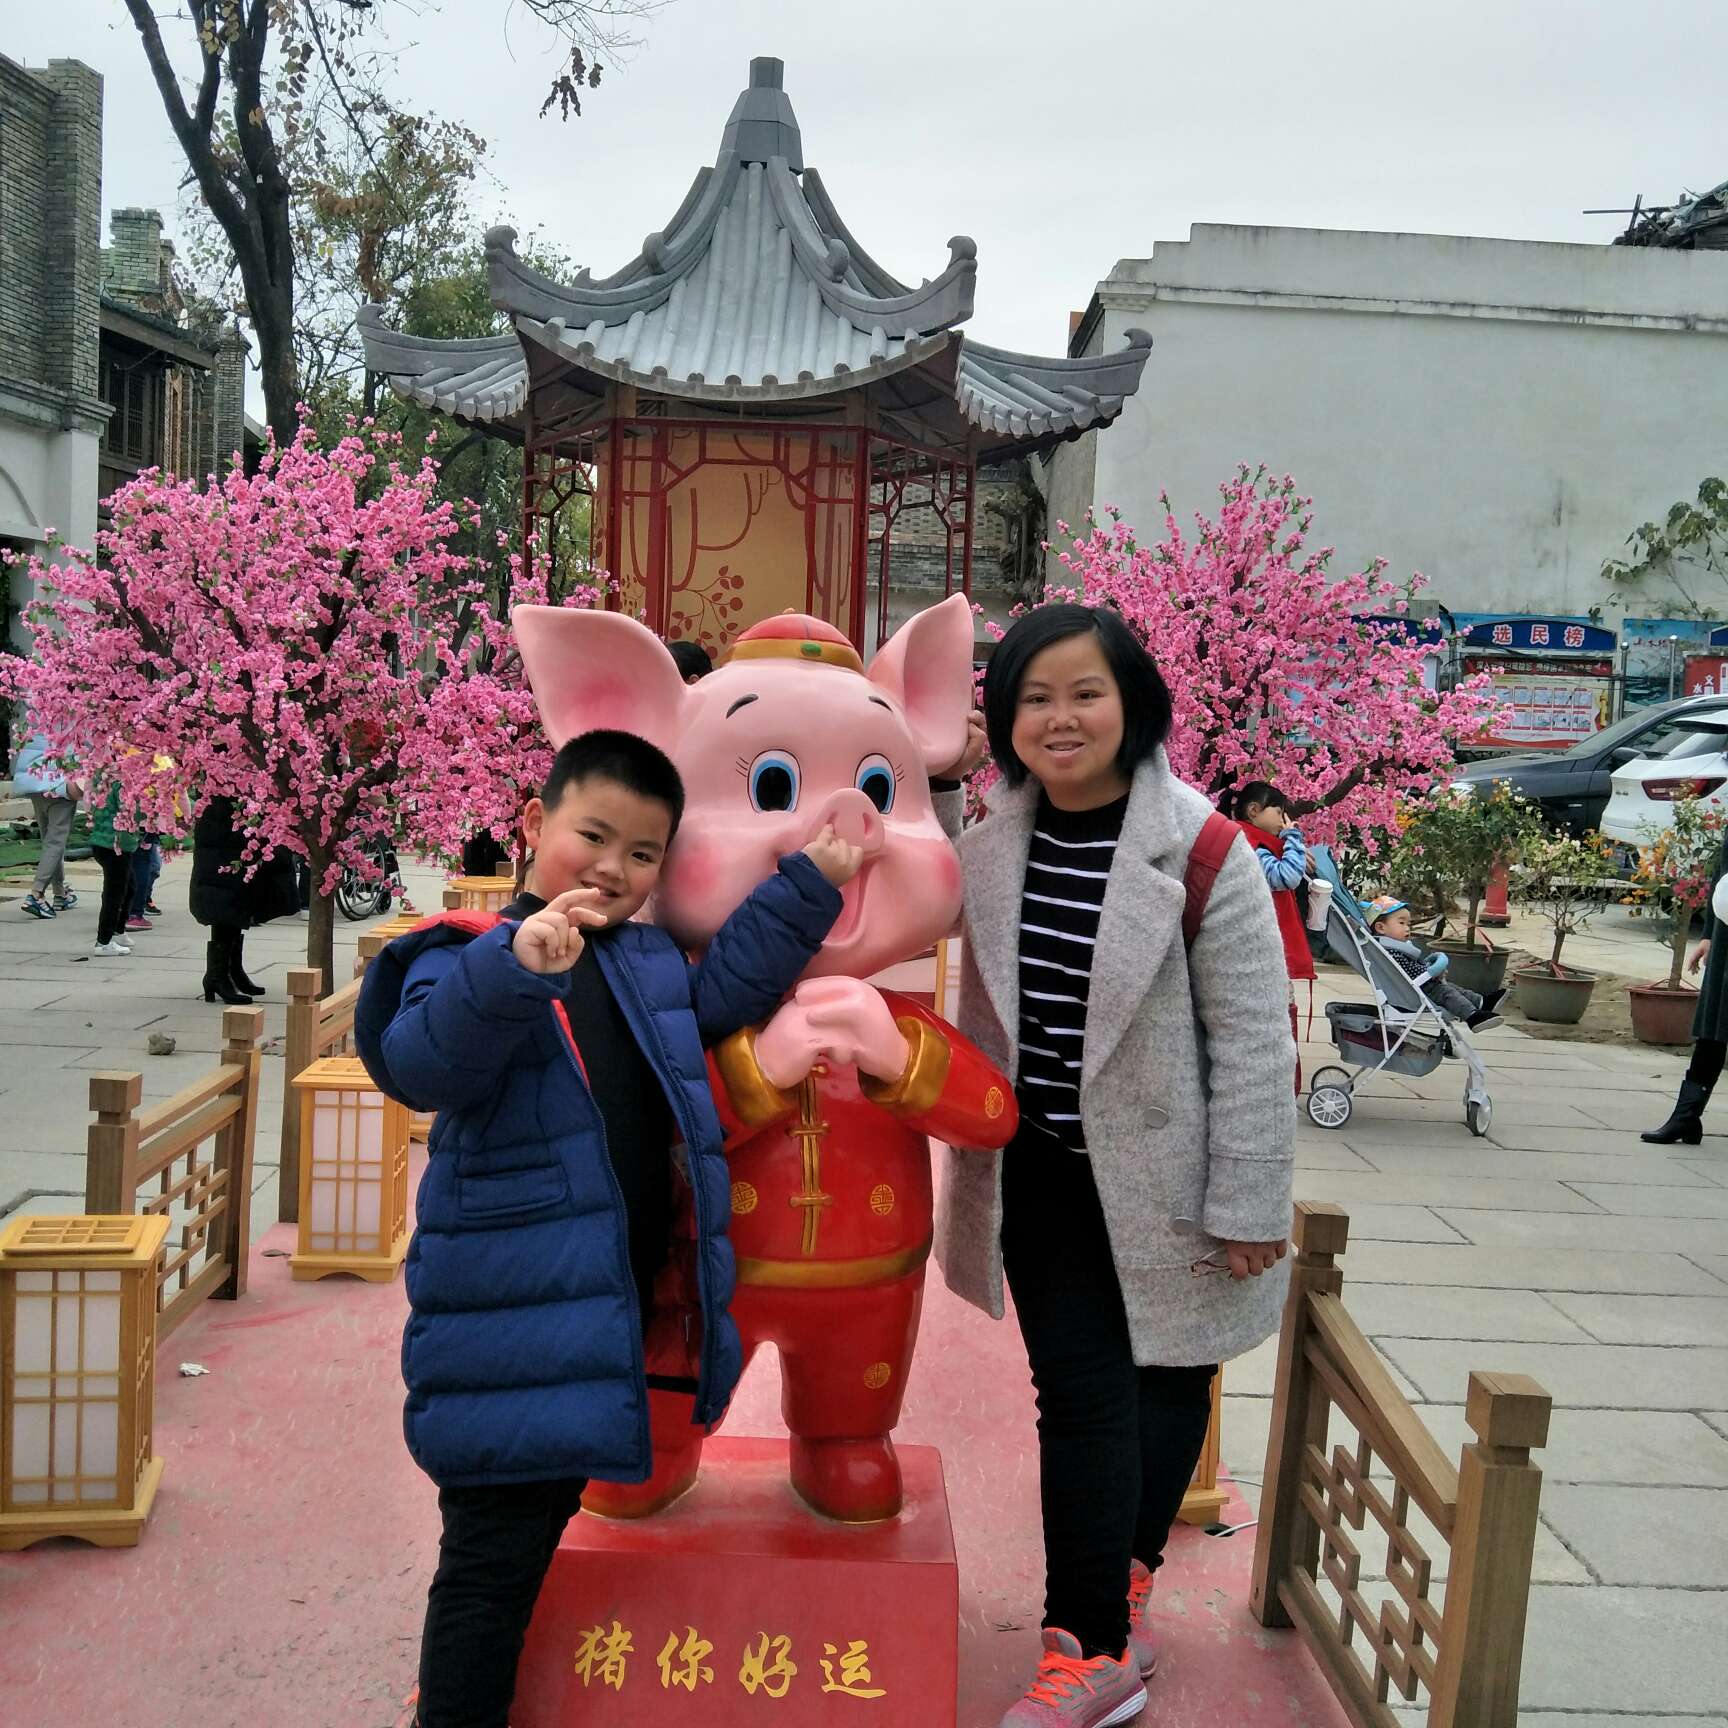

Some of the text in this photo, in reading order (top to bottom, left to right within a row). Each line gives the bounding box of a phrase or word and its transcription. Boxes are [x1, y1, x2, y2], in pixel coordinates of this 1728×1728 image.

[1492, 623, 1585, 648] 选民榜
[574, 1620, 887, 1699] 猪你好运
